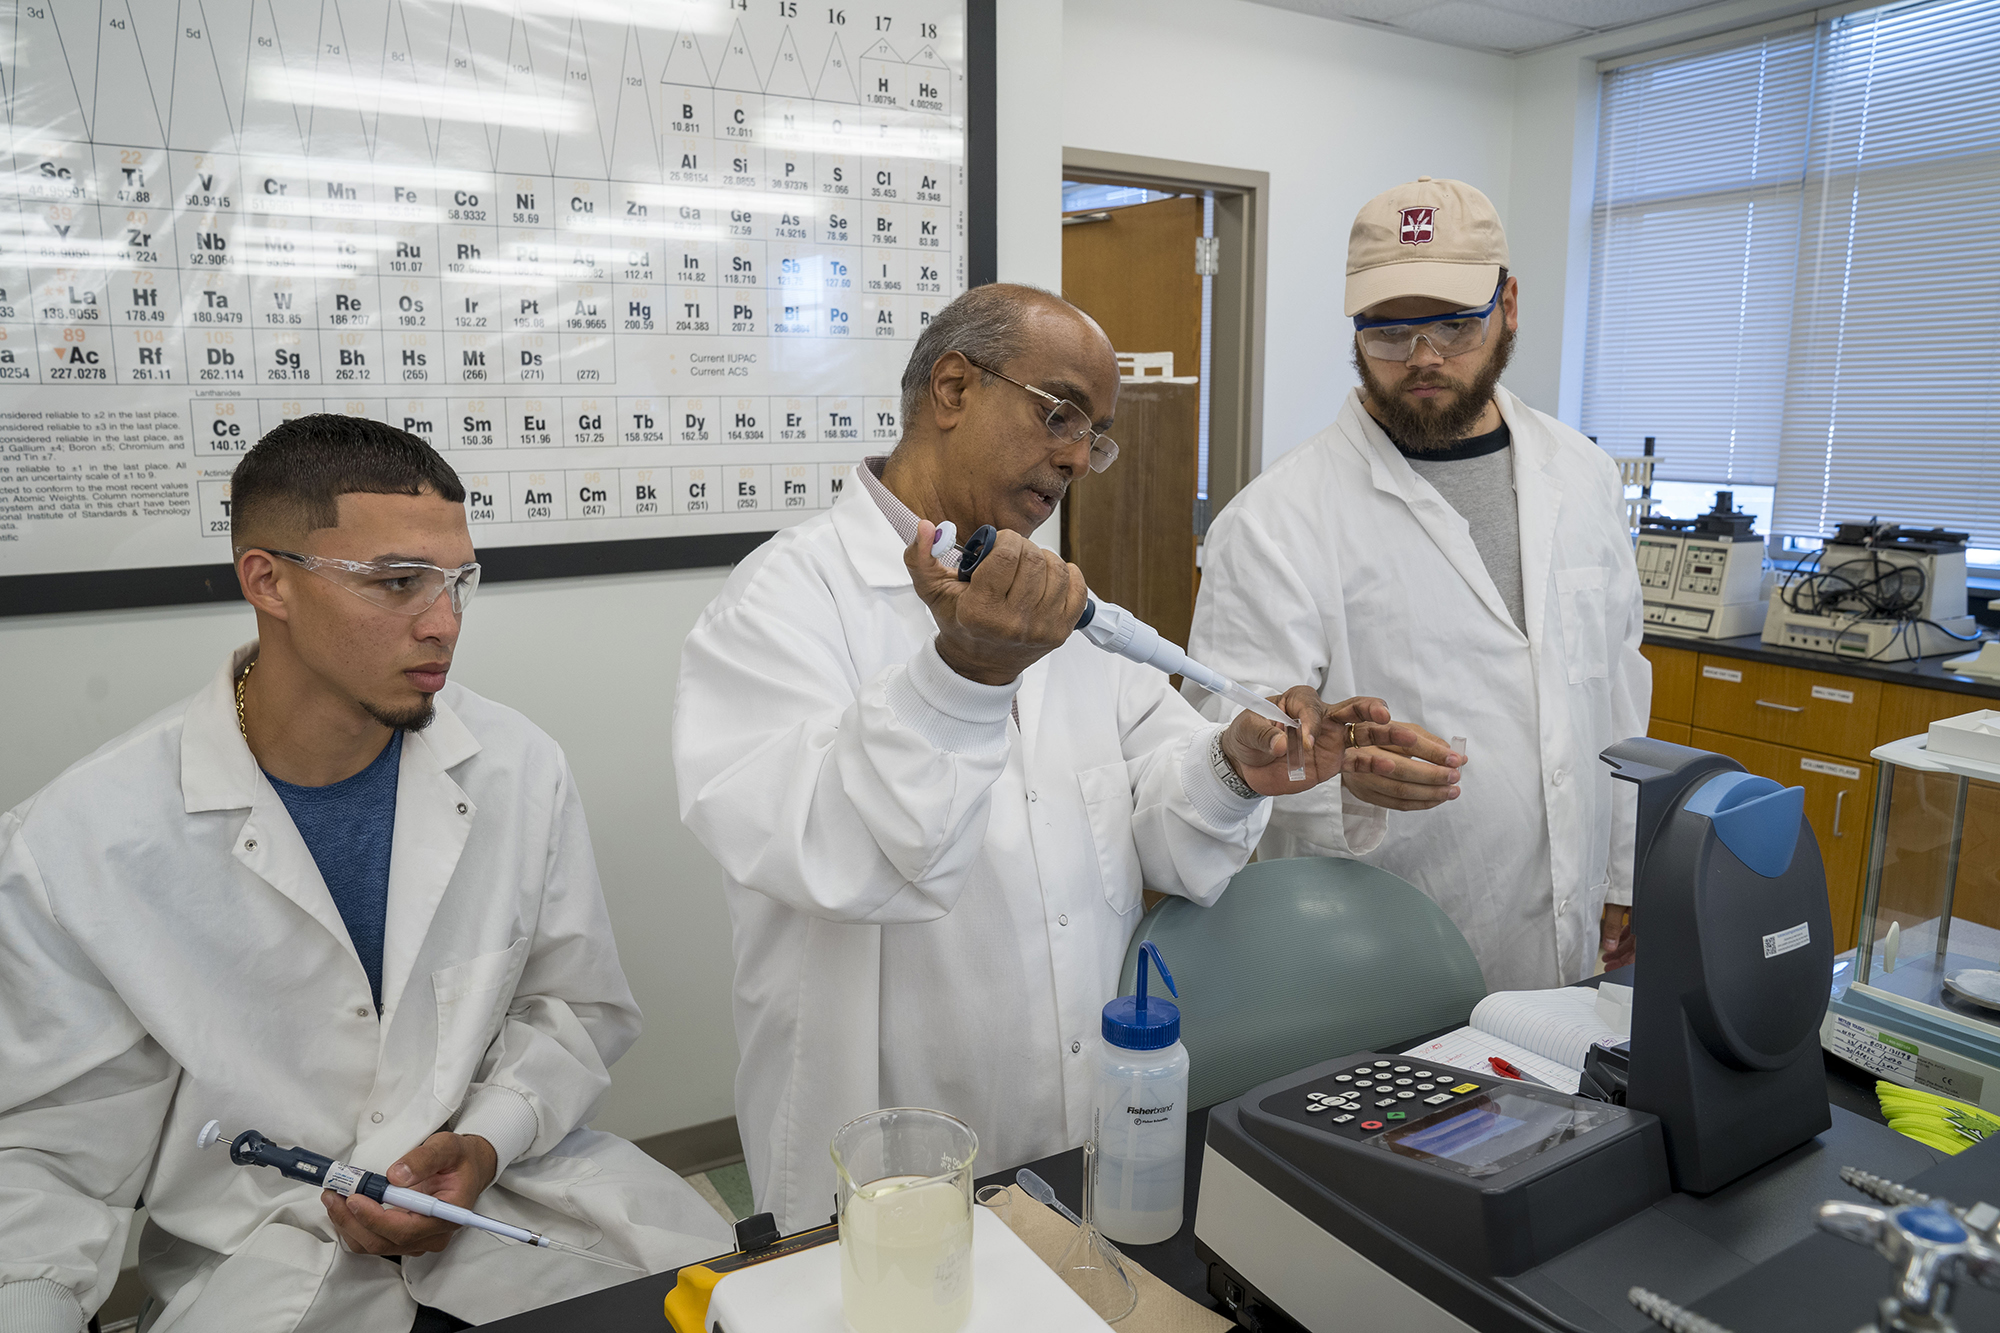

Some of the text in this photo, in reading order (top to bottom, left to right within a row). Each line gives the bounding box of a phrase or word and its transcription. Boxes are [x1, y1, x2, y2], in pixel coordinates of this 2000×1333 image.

[779, 1, 797, 18] 15
[827, 9, 845, 25] 16
[875, 15, 891, 31] 17
[920, 22, 937, 39] 18
[878, 78, 888, 93] H
[919, 83, 938, 98] He
[682, 104, 693, 119] B
[734, 109, 744, 124] C
[671, 121, 700, 133] 10.811
[726, 126, 753, 138] 12.011
[681, 154, 697, 169] Al
[733, 158, 747, 174] Si
[40, 162, 72, 181] Sc
[121, 168, 144, 187] Ti
[785, 163, 795, 178] P
[833, 167, 842, 182] S
[198, 173, 213, 191] V
[877, 171, 891, 186] Cl
[921, 175, 936, 190] Ar
[264, 178, 287, 195] Cr
[327, 182, 356, 200] Mn
[117, 190, 150, 203] 47.88
[394, 186, 417, 203] Fe
[454, 190, 478, 206] Co
[516, 193, 535, 211] Ni
[571, 197, 594, 213] Cu
[626, 200, 647, 217] Zn
[448, 209, 486, 221] 58.9332
[513, 213, 539, 224] 58.69
[679, 205, 700, 221] Ga
[731, 208, 752, 223] Ge
[781, 211, 800, 226] As
[829, 214, 847, 230] Se
[877, 218, 892, 232] Br
[921, 222, 936, 236] Kr
[127, 229, 151, 247] Zr
[197, 232, 226, 251] Nb
[872, 234, 897, 245] 79.904
[395, 241, 421, 258] Ru
[457, 244, 481, 260] Rh
[573, 250, 595, 267] Ag
[628, 251, 649, 267] Cd
[684, 254, 699, 270] In
[732, 256, 752, 272] Sn
[781, 258, 800, 273] Sb
[389, 261, 422, 272] 101.07
[830, 261, 847, 276] Te
[920, 267, 938, 281] Xe
[625, 270, 653, 280] 112.41
[677, 272, 706, 283] 114.82
[724, 273, 756, 285] 118.710
[68, 286, 97, 306] La
[132, 288, 158, 306] Hf
[203, 290, 228, 308] Ta
[274, 292, 292, 310] W
[336, 295, 362, 311] Re
[398, 296, 424, 312] Os
[465, 298, 478, 313] Ir
[520, 299, 539, 315] Pt
[575, 300, 596, 316] Au
[628, 302, 651, 320] Hg
[685, 303, 700, 318] Tl
[125, 310, 165, 322] 178.49
[733, 305, 752, 320] Pb
[784, 307, 799, 322] Bi
[830, 309, 848, 323] Po
[877, 310, 892, 324] At
[399, 316, 426, 326] 190.2
[455, 317, 487, 327] 192.22
[624, 320, 654, 331] 200.59
[732, 322, 754, 333] 207.2
[69, 346, 99, 364] Ac
[138, 347, 162, 365] Rf
[207, 348, 235, 365] Db
[275, 349, 301, 369] Sg
[339, 349, 365, 366] Bh
[402, 350, 426, 366] Hs
[463, 351, 485, 366] Mt
[521, 351, 542, 366] Ds
[690, 353, 757, 363] Current IUPAC
[51, 368, 106, 380] 227.0278
[132, 369, 171, 380] 261.11
[200, 369, 244, 380] 262.114
[267, 369, 310, 380] 263.118
[336, 369, 370, 380] 262.12
[402, 369, 428, 381] (265)
[462, 369, 487, 381] (266)
[520, 369, 544, 381] (271)
[576, 369, 600, 381] (272)
[690, 366, 749, 376] Current ACS
[195, 389, 241, 397] Lanthanides
[403, 417, 433, 433] Pm
[463, 416, 492, 432] Sm
[524, 415, 546, 431] Eu
[579, 415, 601, 430] Gd
[633, 414, 654, 430] Tb
[685, 414, 705, 431] Dy
[735, 413, 755, 428] Ho
[786, 413, 802, 428] Er
[829, 413, 852, 427] Tm
[877, 412, 895, 427] Yb
[213, 420, 240, 436] Ce
[681, 430, 709, 441] 162.50
[461, 435, 493, 445] 150.36
[520, 434, 551, 444] 151.96
[575, 433, 604, 443] 157.25
[625, 431, 663, 442] 158.9254
[579, 487, 606, 502] Cm
[636, 485, 656, 500] Bk
[688, 483, 706, 498] Cf
[738, 482, 756, 497] Es
[784, 480, 806, 495] Fm
[470, 491, 493, 506] Pu
[524, 489, 552, 504] Am
[737, 498, 758, 510] (252)
[527, 507, 551, 518] (243)
[582, 505, 605, 516] (247)
[635, 502, 658, 514] (247)
[687, 500, 709, 512] (251)
[27, 512, 64, 520] Institute
[81, 510, 127, 518] Standards
[143, 508, 191, 517] Technology
[470, 509, 494, 520] (244)
[1127, 1103, 1173, 1114] Fisherbrand
